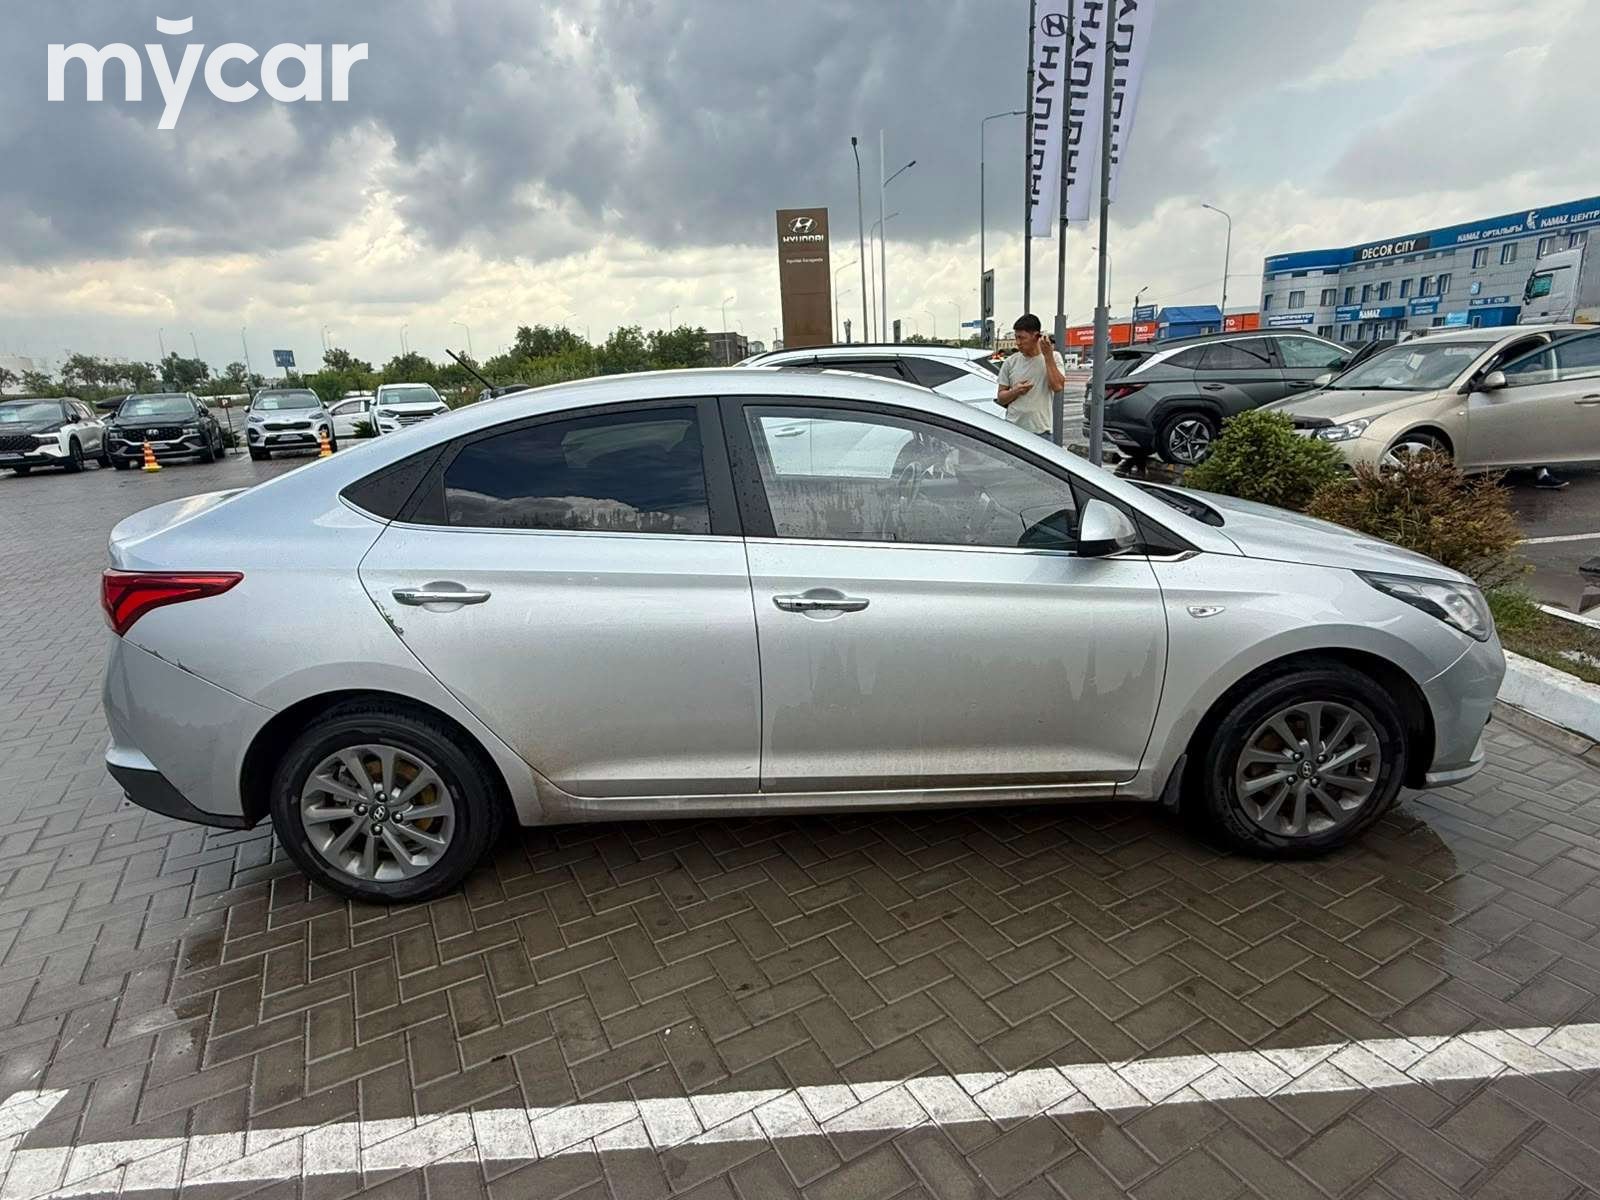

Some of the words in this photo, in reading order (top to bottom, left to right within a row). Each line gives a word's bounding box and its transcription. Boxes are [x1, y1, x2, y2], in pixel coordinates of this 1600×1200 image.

[783, 234, 824, 243] HYUNDAI
[1362, 244, 1393, 260] DECOR
[1395, 240, 1417, 253] CITY
